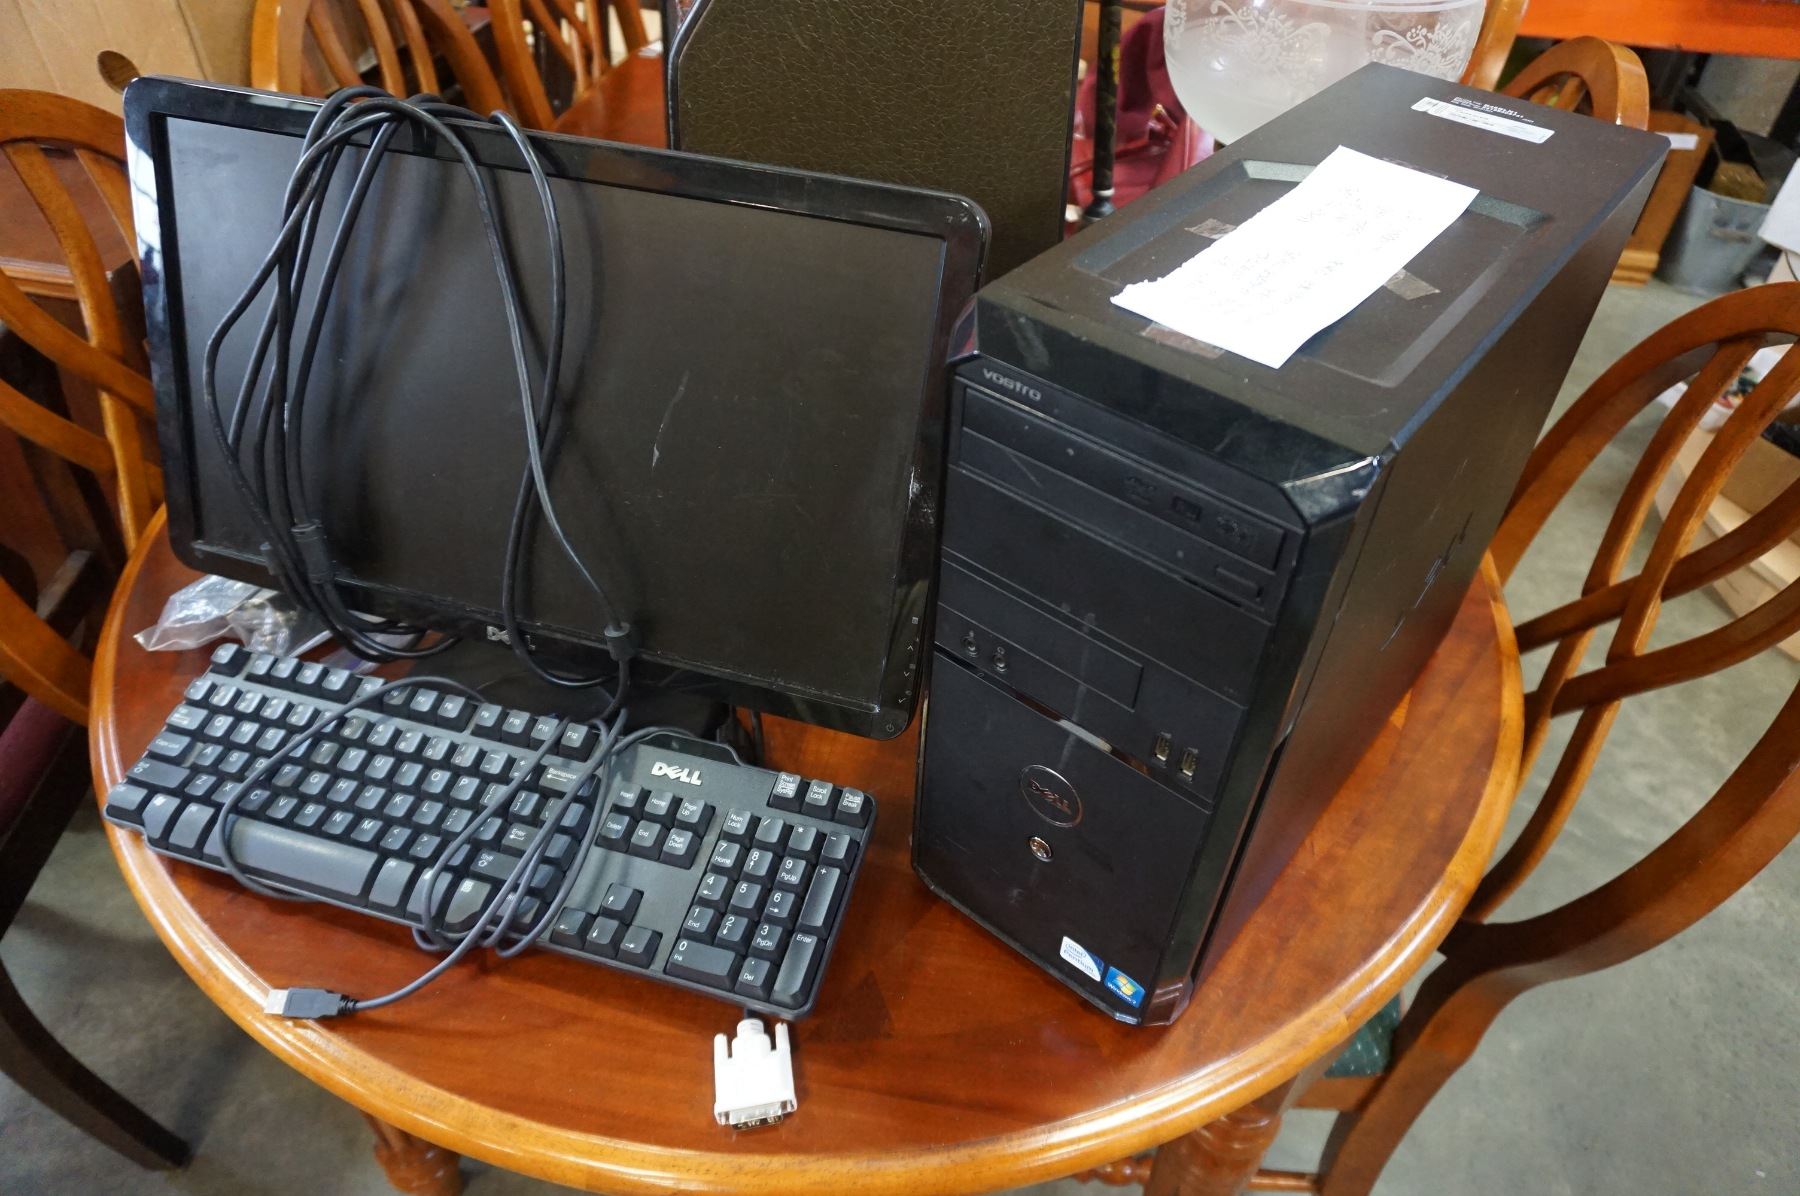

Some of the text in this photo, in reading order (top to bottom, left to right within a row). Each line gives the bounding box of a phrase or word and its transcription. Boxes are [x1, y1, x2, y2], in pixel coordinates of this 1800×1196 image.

[266, 730, 276, 738] E
[202, 746, 214, 754] A
[322, 744, 329, 752] T
[229, 752, 238, 760] S
[349, 750, 356, 758] Y
[256, 759, 264, 768] D
[374, 758, 384, 766] U
[283, 766, 292, 774] F
[650, 762, 702, 786] DELL
[196, 775, 208, 784] Z
[460, 778, 468, 786] P
[782, 774, 794, 782] Print
[222, 783, 232, 792] X
[337, 782, 348, 790] H
[812, 786, 828, 794] Scroll
[250, 790, 260, 800] C
[365, 788, 374, 796] J
[810, 792, 823, 800] Lock
[279, 798, 288, 806] V
[394, 796, 404, 804] K
[845, 793, 861, 802] Pause
[652, 798, 666, 807] Home
[684, 802, 697, 811] Page
[842, 800, 858, 808] Break
[304, 805, 314, 814] B
[682, 808, 690, 816] Up
[332, 813, 343, 822] N
[730, 814, 744, 822] Num
[362, 820, 374, 830] M
[728, 820, 741, 828] Lock
[638, 830, 650, 838] End
[672, 834, 684, 844] Page
[668, 840, 684, 848] Down
[720, 843, 728, 852] 7
[714, 855, 731, 865] Home
[751, 852, 760, 861] 8
[784, 860, 793, 870] 9
[706, 876, 715, 886] 4
[780, 872, 797, 882] PgUp
[740, 883, 748, 894] 5
[773, 892, 782, 902] 6
[694, 908, 700, 918] 1
[688, 920, 700, 928] End
[726, 916, 735, 926] 2
[760, 925, 769, 936] 3
[756, 938, 773, 947] PgDn
[796, 934, 812, 943] Enter
[679, 941, 688, 951] 0
[744, 972, 754, 981] Del
